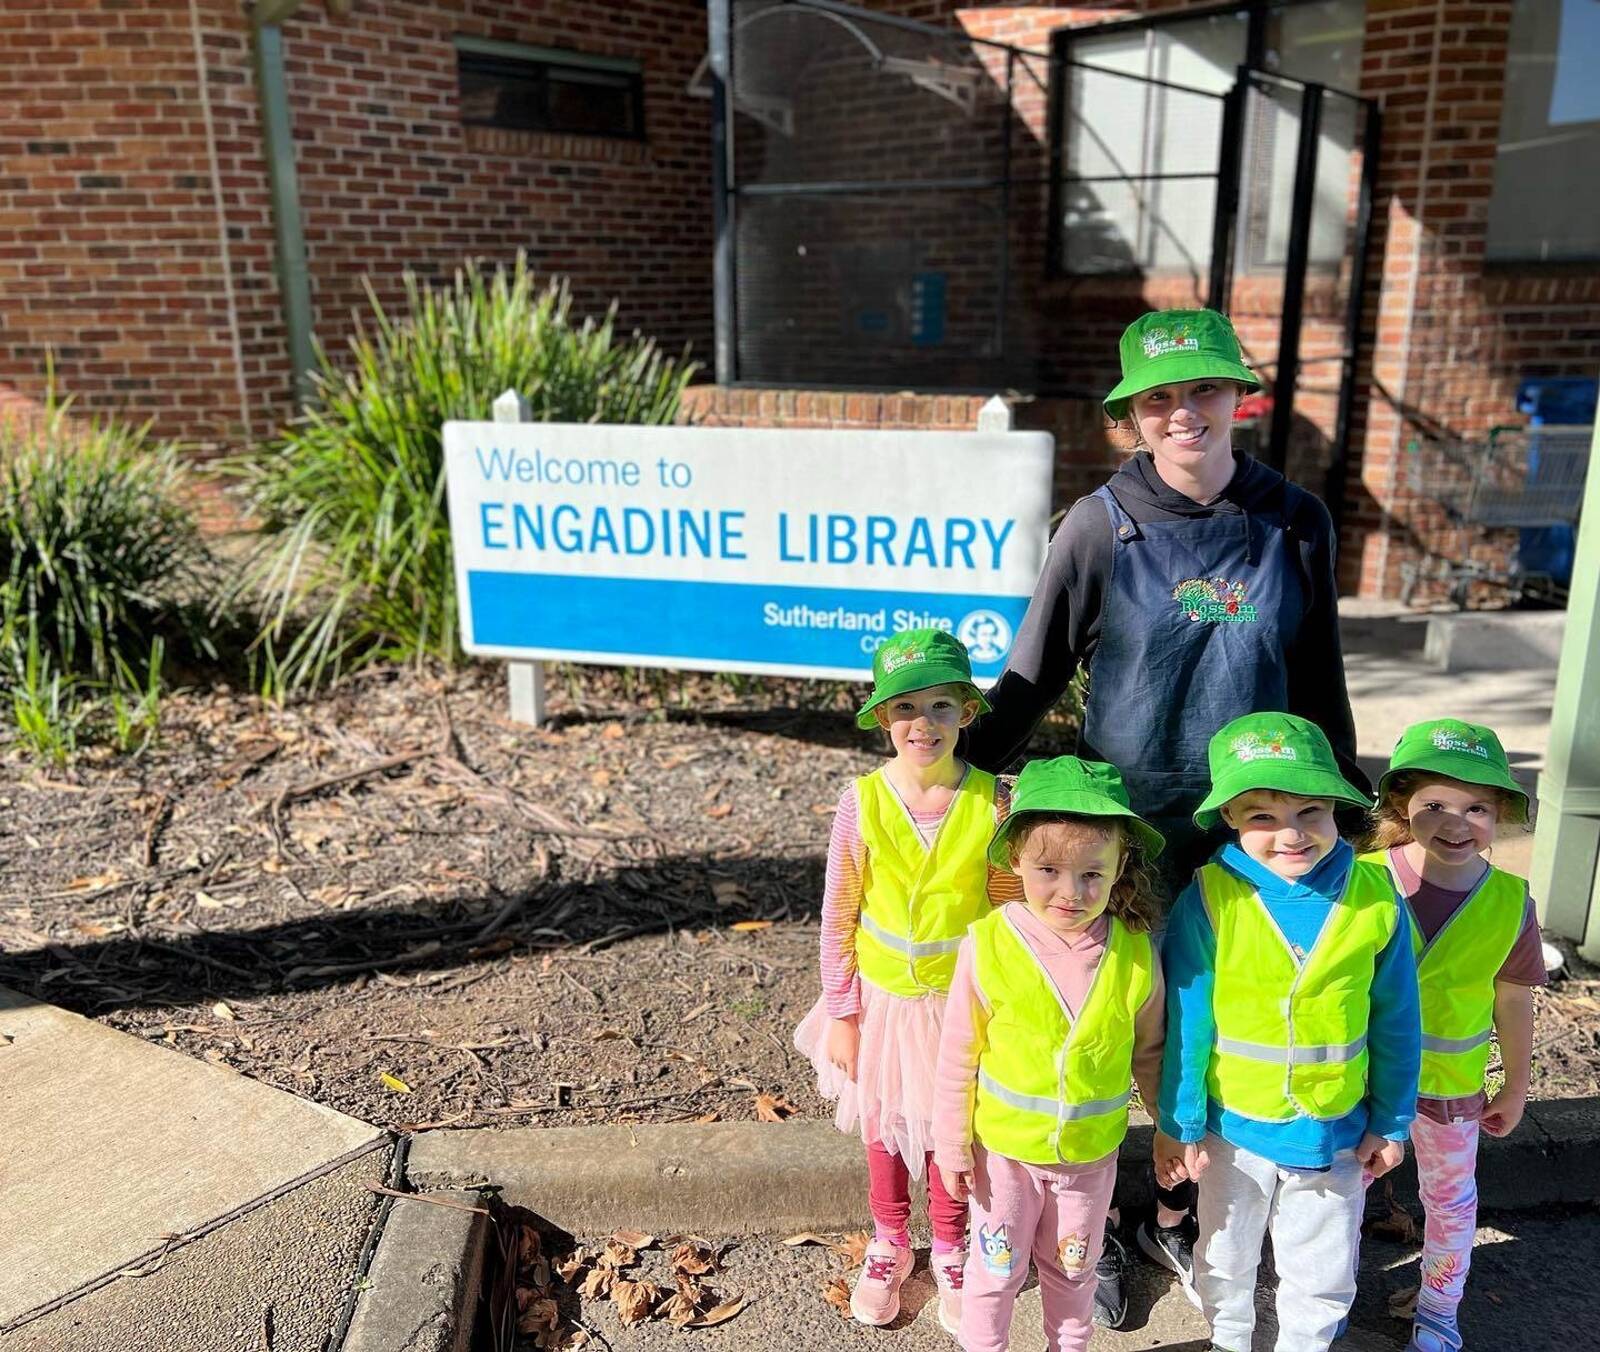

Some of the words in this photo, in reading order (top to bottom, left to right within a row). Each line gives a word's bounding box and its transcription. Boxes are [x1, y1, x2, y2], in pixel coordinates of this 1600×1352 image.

[475, 447, 640, 487] Welcome
[656, 457, 692, 488] to
[480, 502, 747, 559] ENGADINE
[778, 512, 1015, 570] LIBRARY
[763, 602, 886, 632] Sutherland
[892, 609, 953, 634] Shire
[1200, 612, 1257, 622] Preschool
